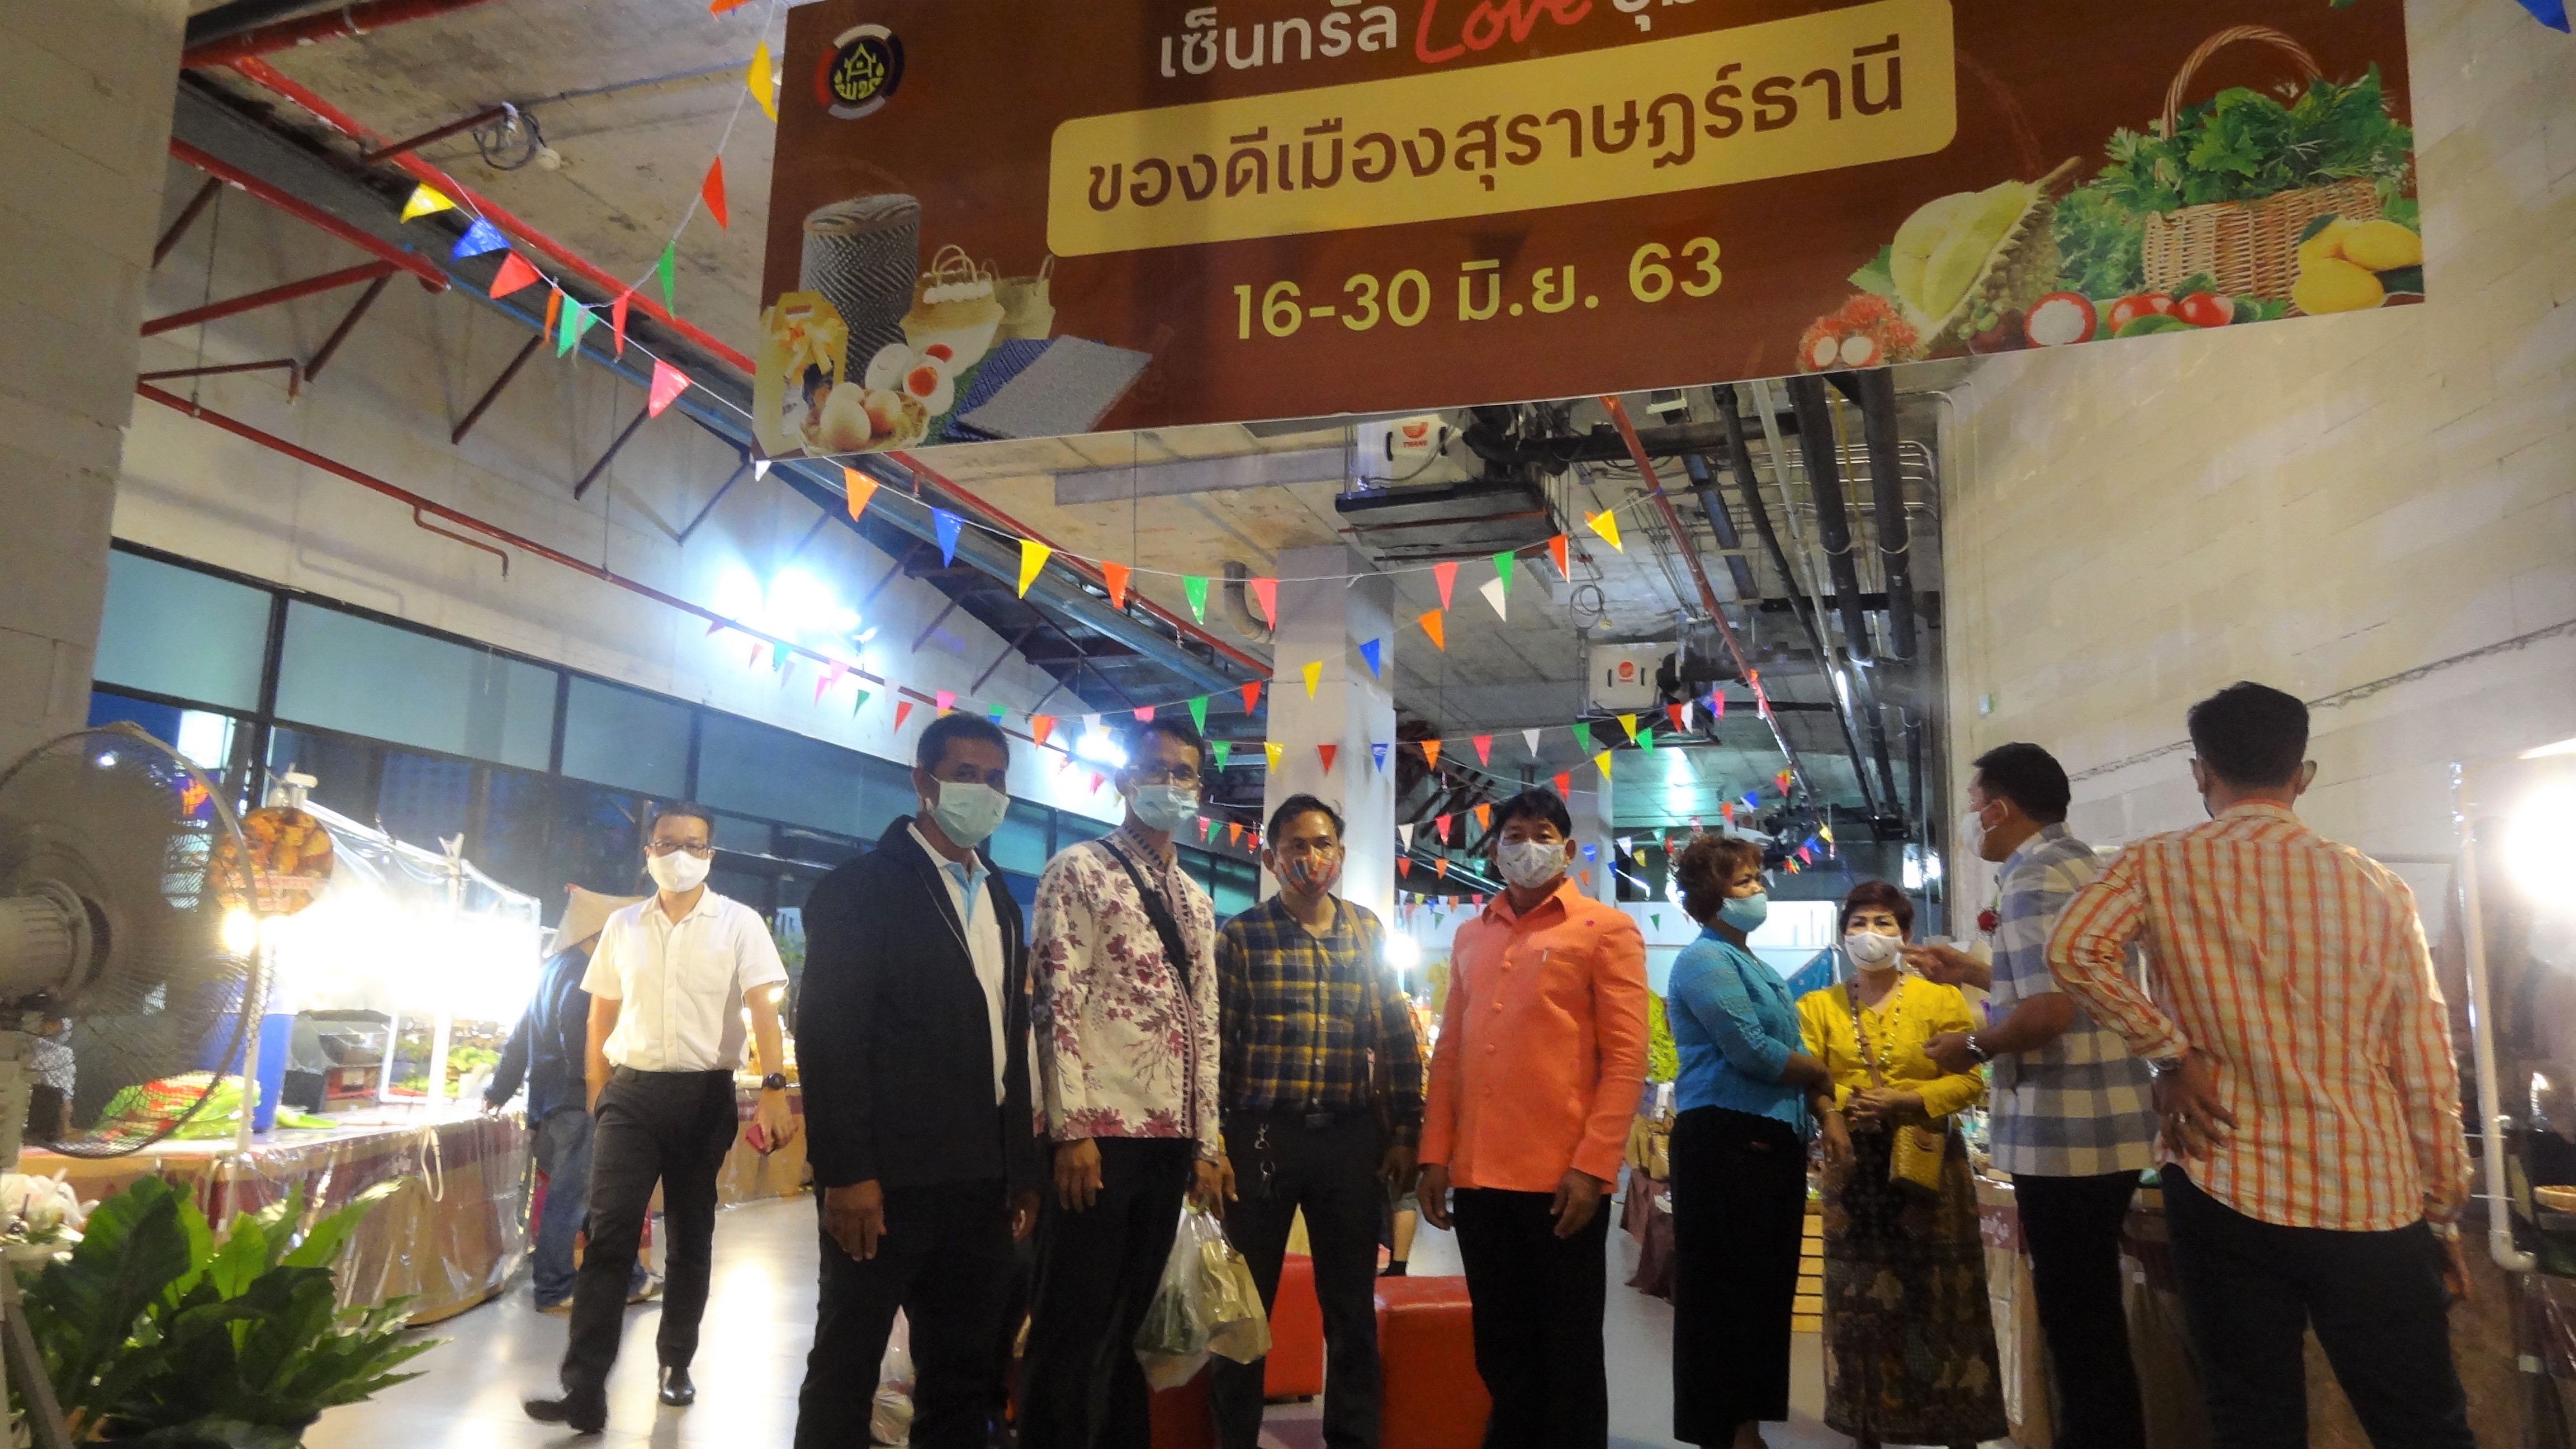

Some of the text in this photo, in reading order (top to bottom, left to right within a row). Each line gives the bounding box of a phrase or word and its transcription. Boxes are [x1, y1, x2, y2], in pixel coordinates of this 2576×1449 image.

[1088, 34, 1902, 212] ของดีเมืองสุราษฎร์ธานี
[1233, 236, 1723, 340] 16-30 มิ.ย. 63
